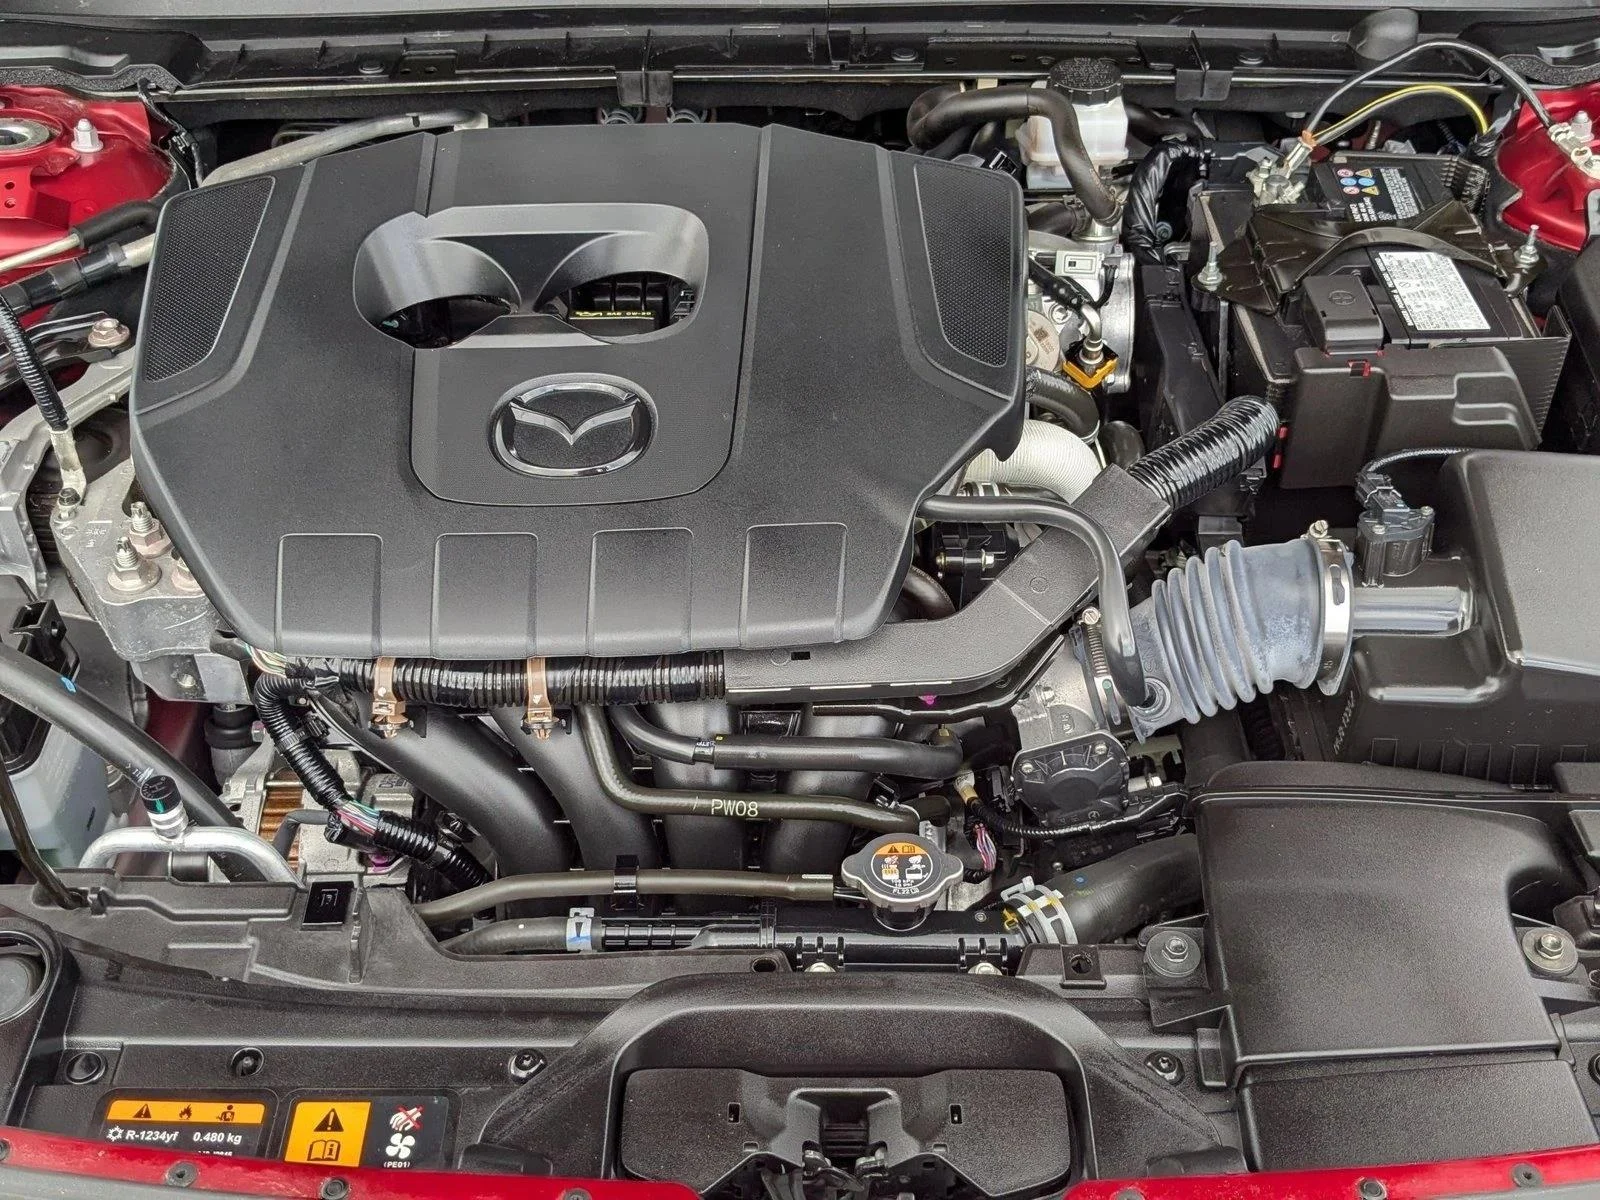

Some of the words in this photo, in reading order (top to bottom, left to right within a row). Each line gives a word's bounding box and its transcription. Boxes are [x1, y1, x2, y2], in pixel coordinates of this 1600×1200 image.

[711, 798, 759, 817] PW08
[125, 1129, 180, 1143] R-1234yf
[193, 1131, 225, 1142] 0.480
[227, 1132, 243, 1145] kg
